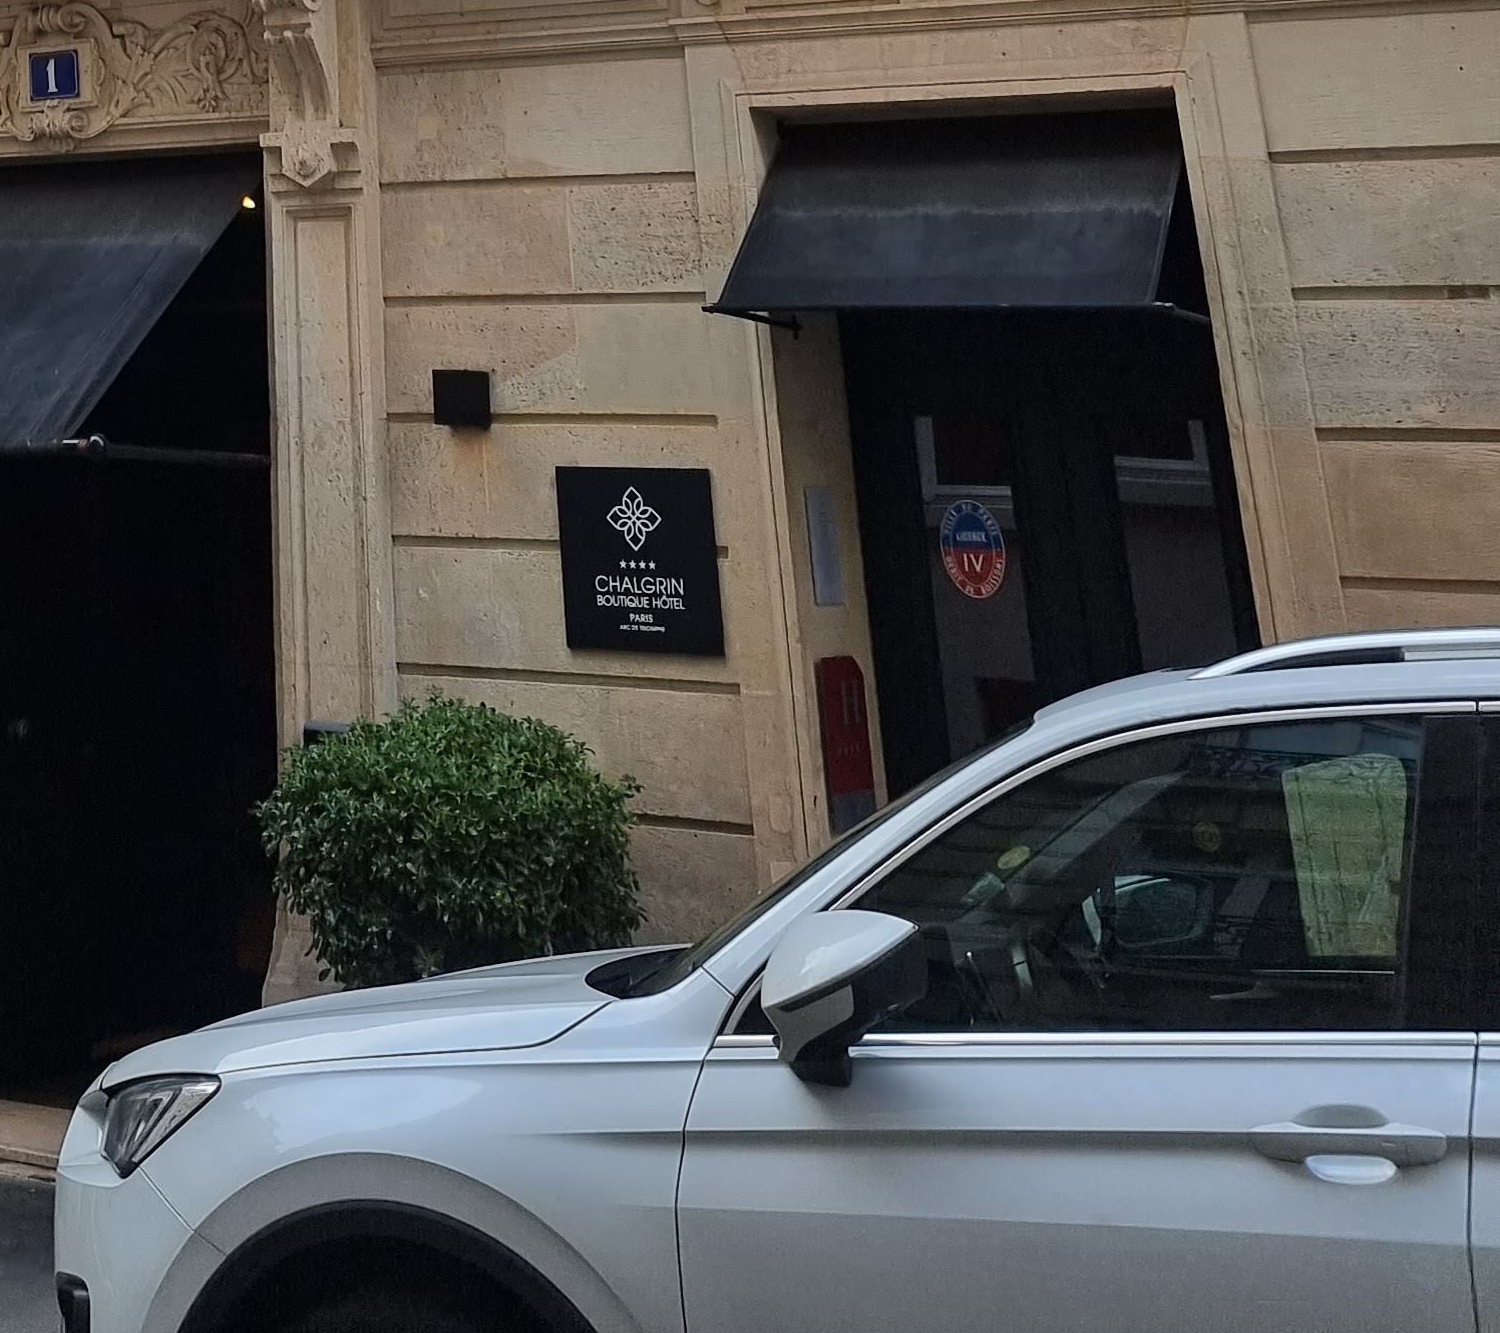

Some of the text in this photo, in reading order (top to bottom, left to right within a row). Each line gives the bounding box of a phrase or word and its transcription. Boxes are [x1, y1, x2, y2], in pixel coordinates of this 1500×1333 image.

[46, 58, 59, 93] 1
[963, 553, 984, 573] IV
[595, 575, 684, 595] CHALGRIN
[596, 594, 686, 610] BOUTIQUE HÔTEL
[629, 613, 654, 623] PARIS
